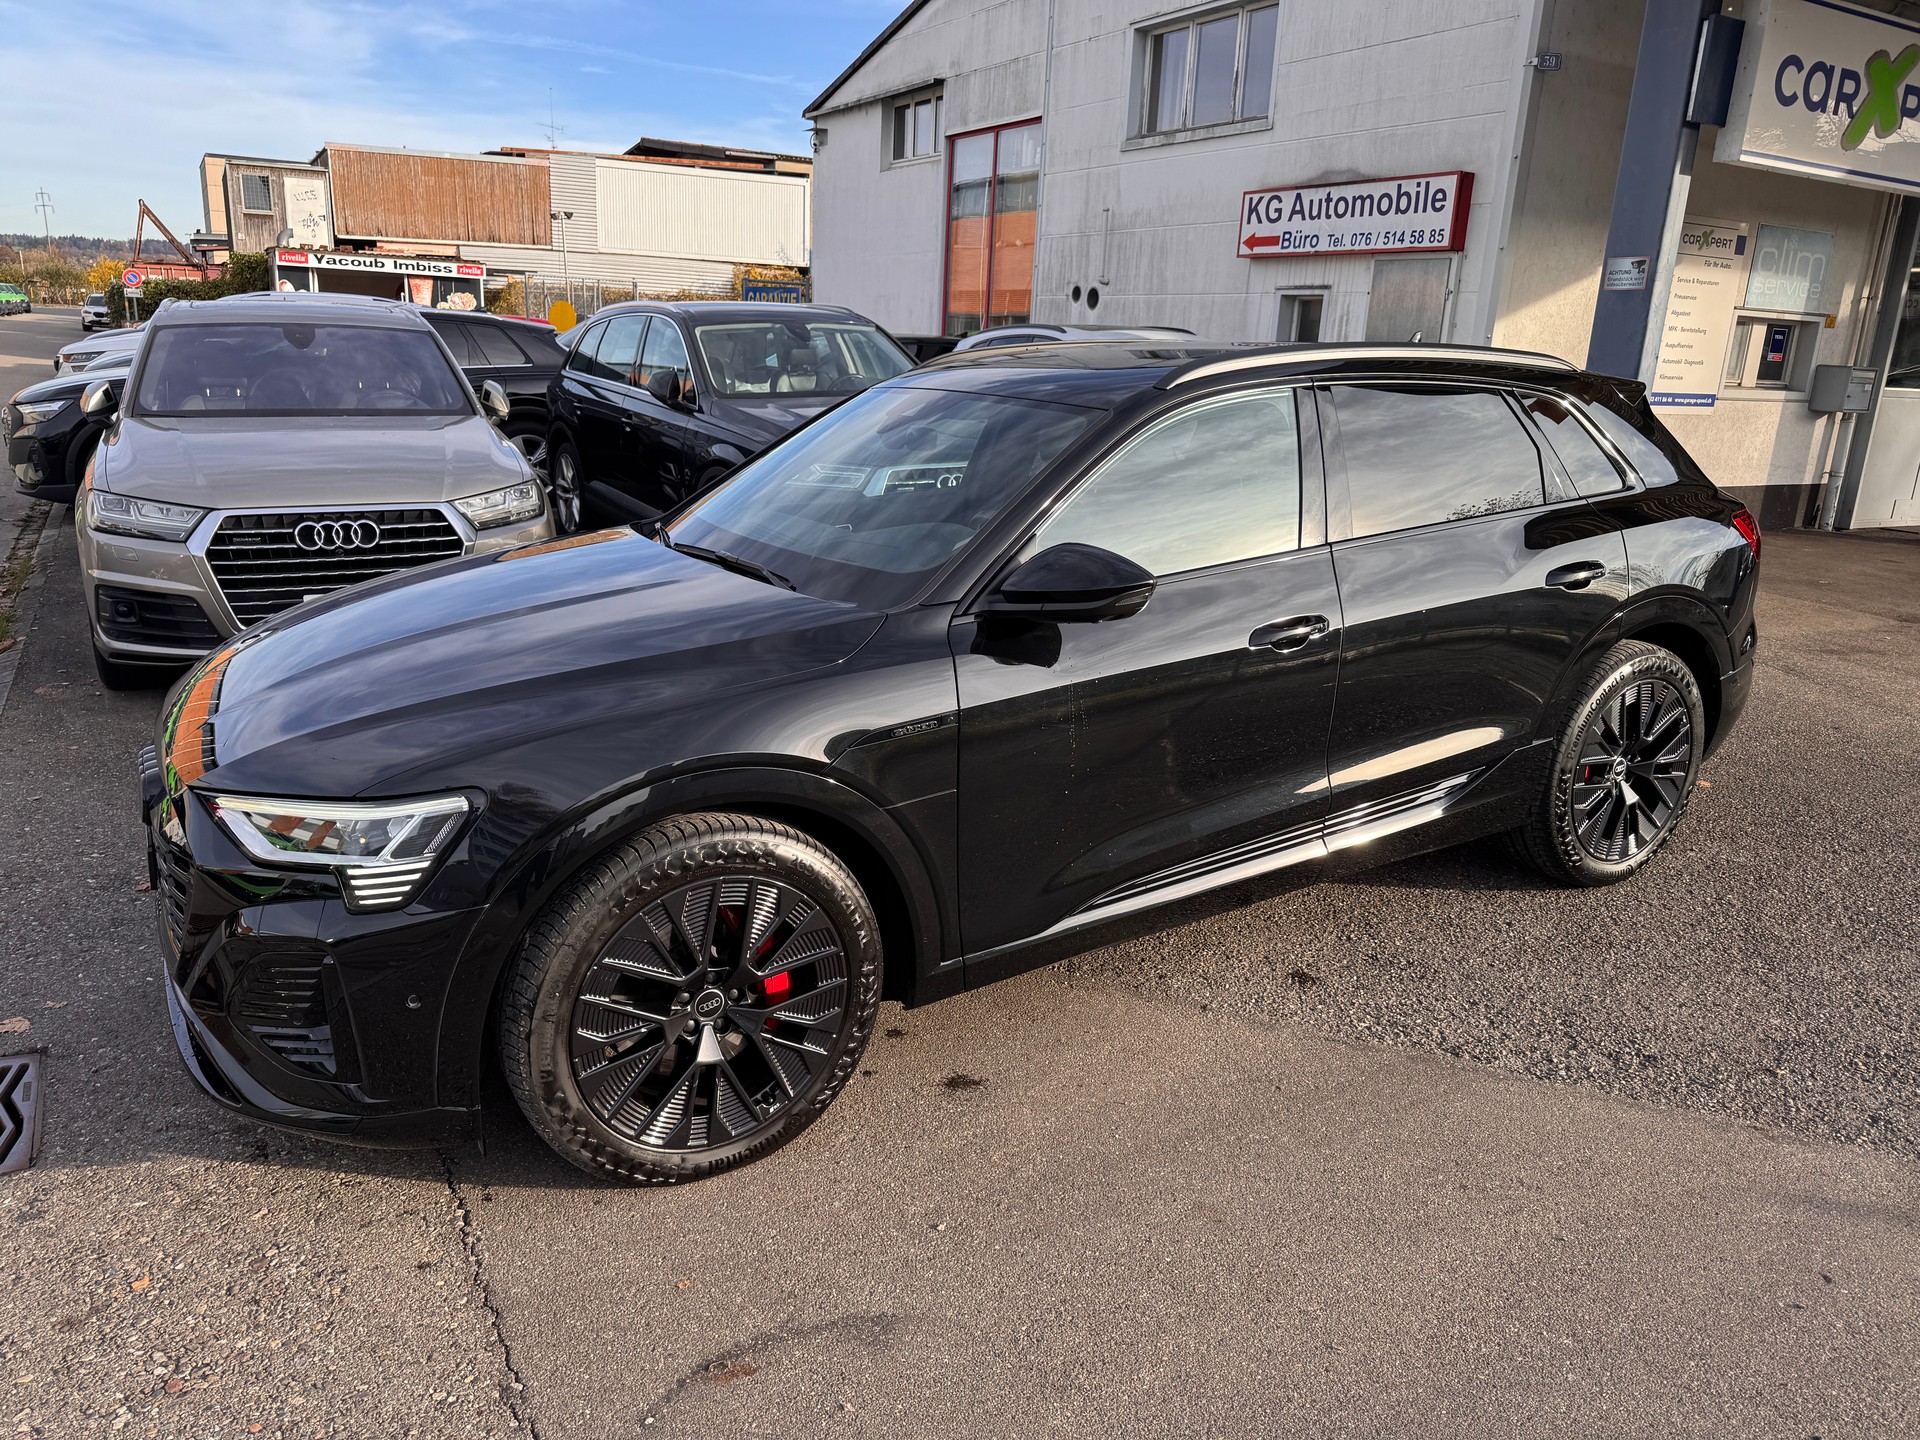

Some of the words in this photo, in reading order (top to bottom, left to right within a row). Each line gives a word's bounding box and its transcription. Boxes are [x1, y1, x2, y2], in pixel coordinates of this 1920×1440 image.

[1543, 56, 1556, 67] 39
[1246, 194, 1283, 226] KG
[1287, 180, 1448, 222] Automobile
[1280, 230, 1320, 250] Büro
[1327, 234, 1346, 248] Tel.
[1350, 232, 1372, 247] 076
[1382, 231, 1405, 245] 514
[1408, 230, 1425, 244] 58
[1428, 229, 1445, 243] 85
[278, 254, 307, 264] rivella
[313, 254, 386, 269] Yacoub
[393, 260, 453, 273] Imbiss
[459, 267, 483, 275] rivella
[1757, 238, 1826, 281] clim
[1677, 276, 1692, 284] Service
[1752, 277, 1821, 298] service
[1566, 675, 1620, 760] PremiumContact
[1618, 671, 1625, 681] 6
